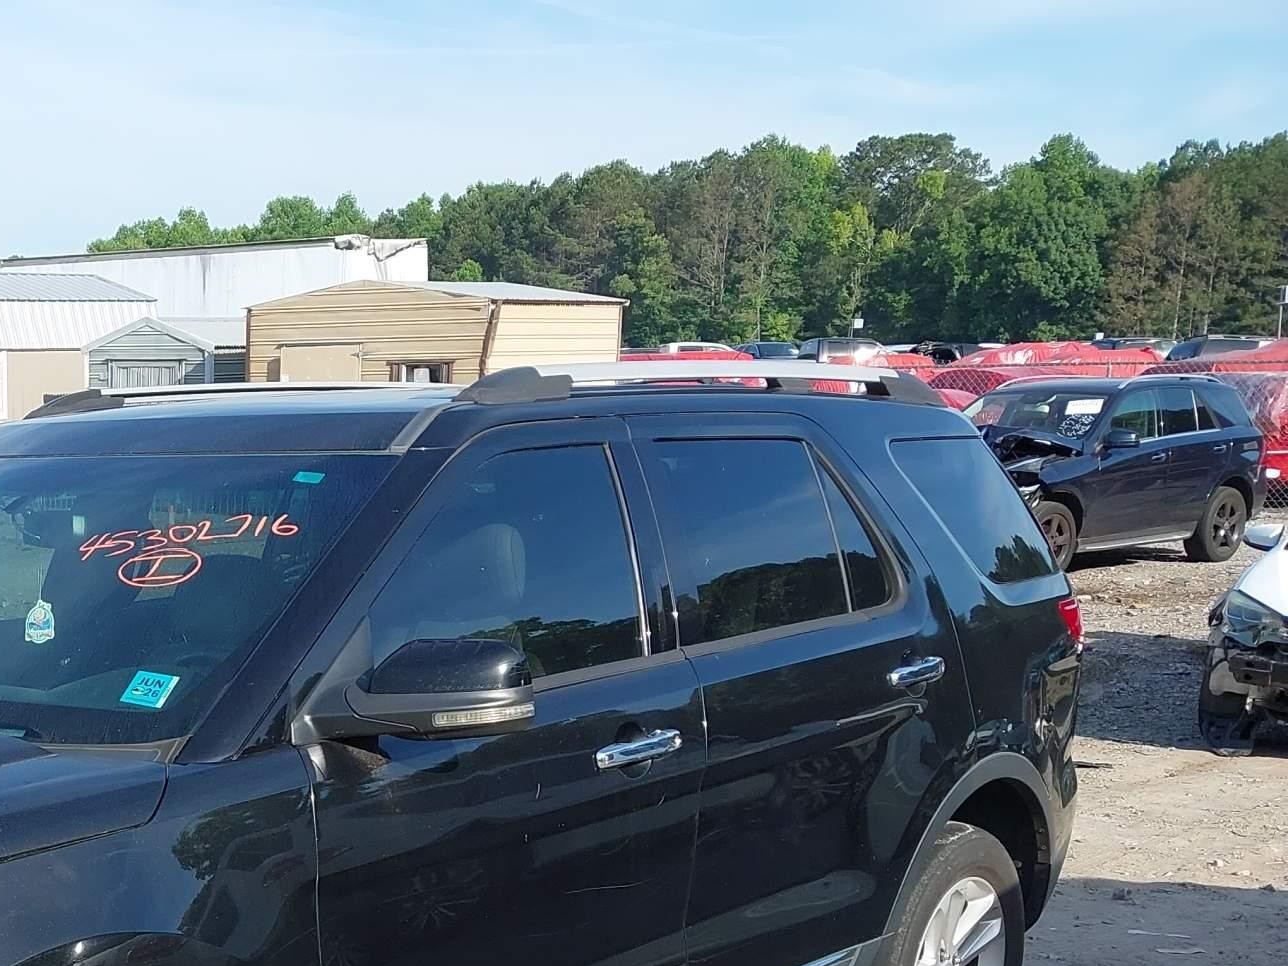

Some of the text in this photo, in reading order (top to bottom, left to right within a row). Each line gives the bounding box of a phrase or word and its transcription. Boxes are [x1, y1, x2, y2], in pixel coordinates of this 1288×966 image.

[79, 514, 299, 561] 45302716
[137, 677, 165, 688] JUN
[143, 688, 160, 698] 26
